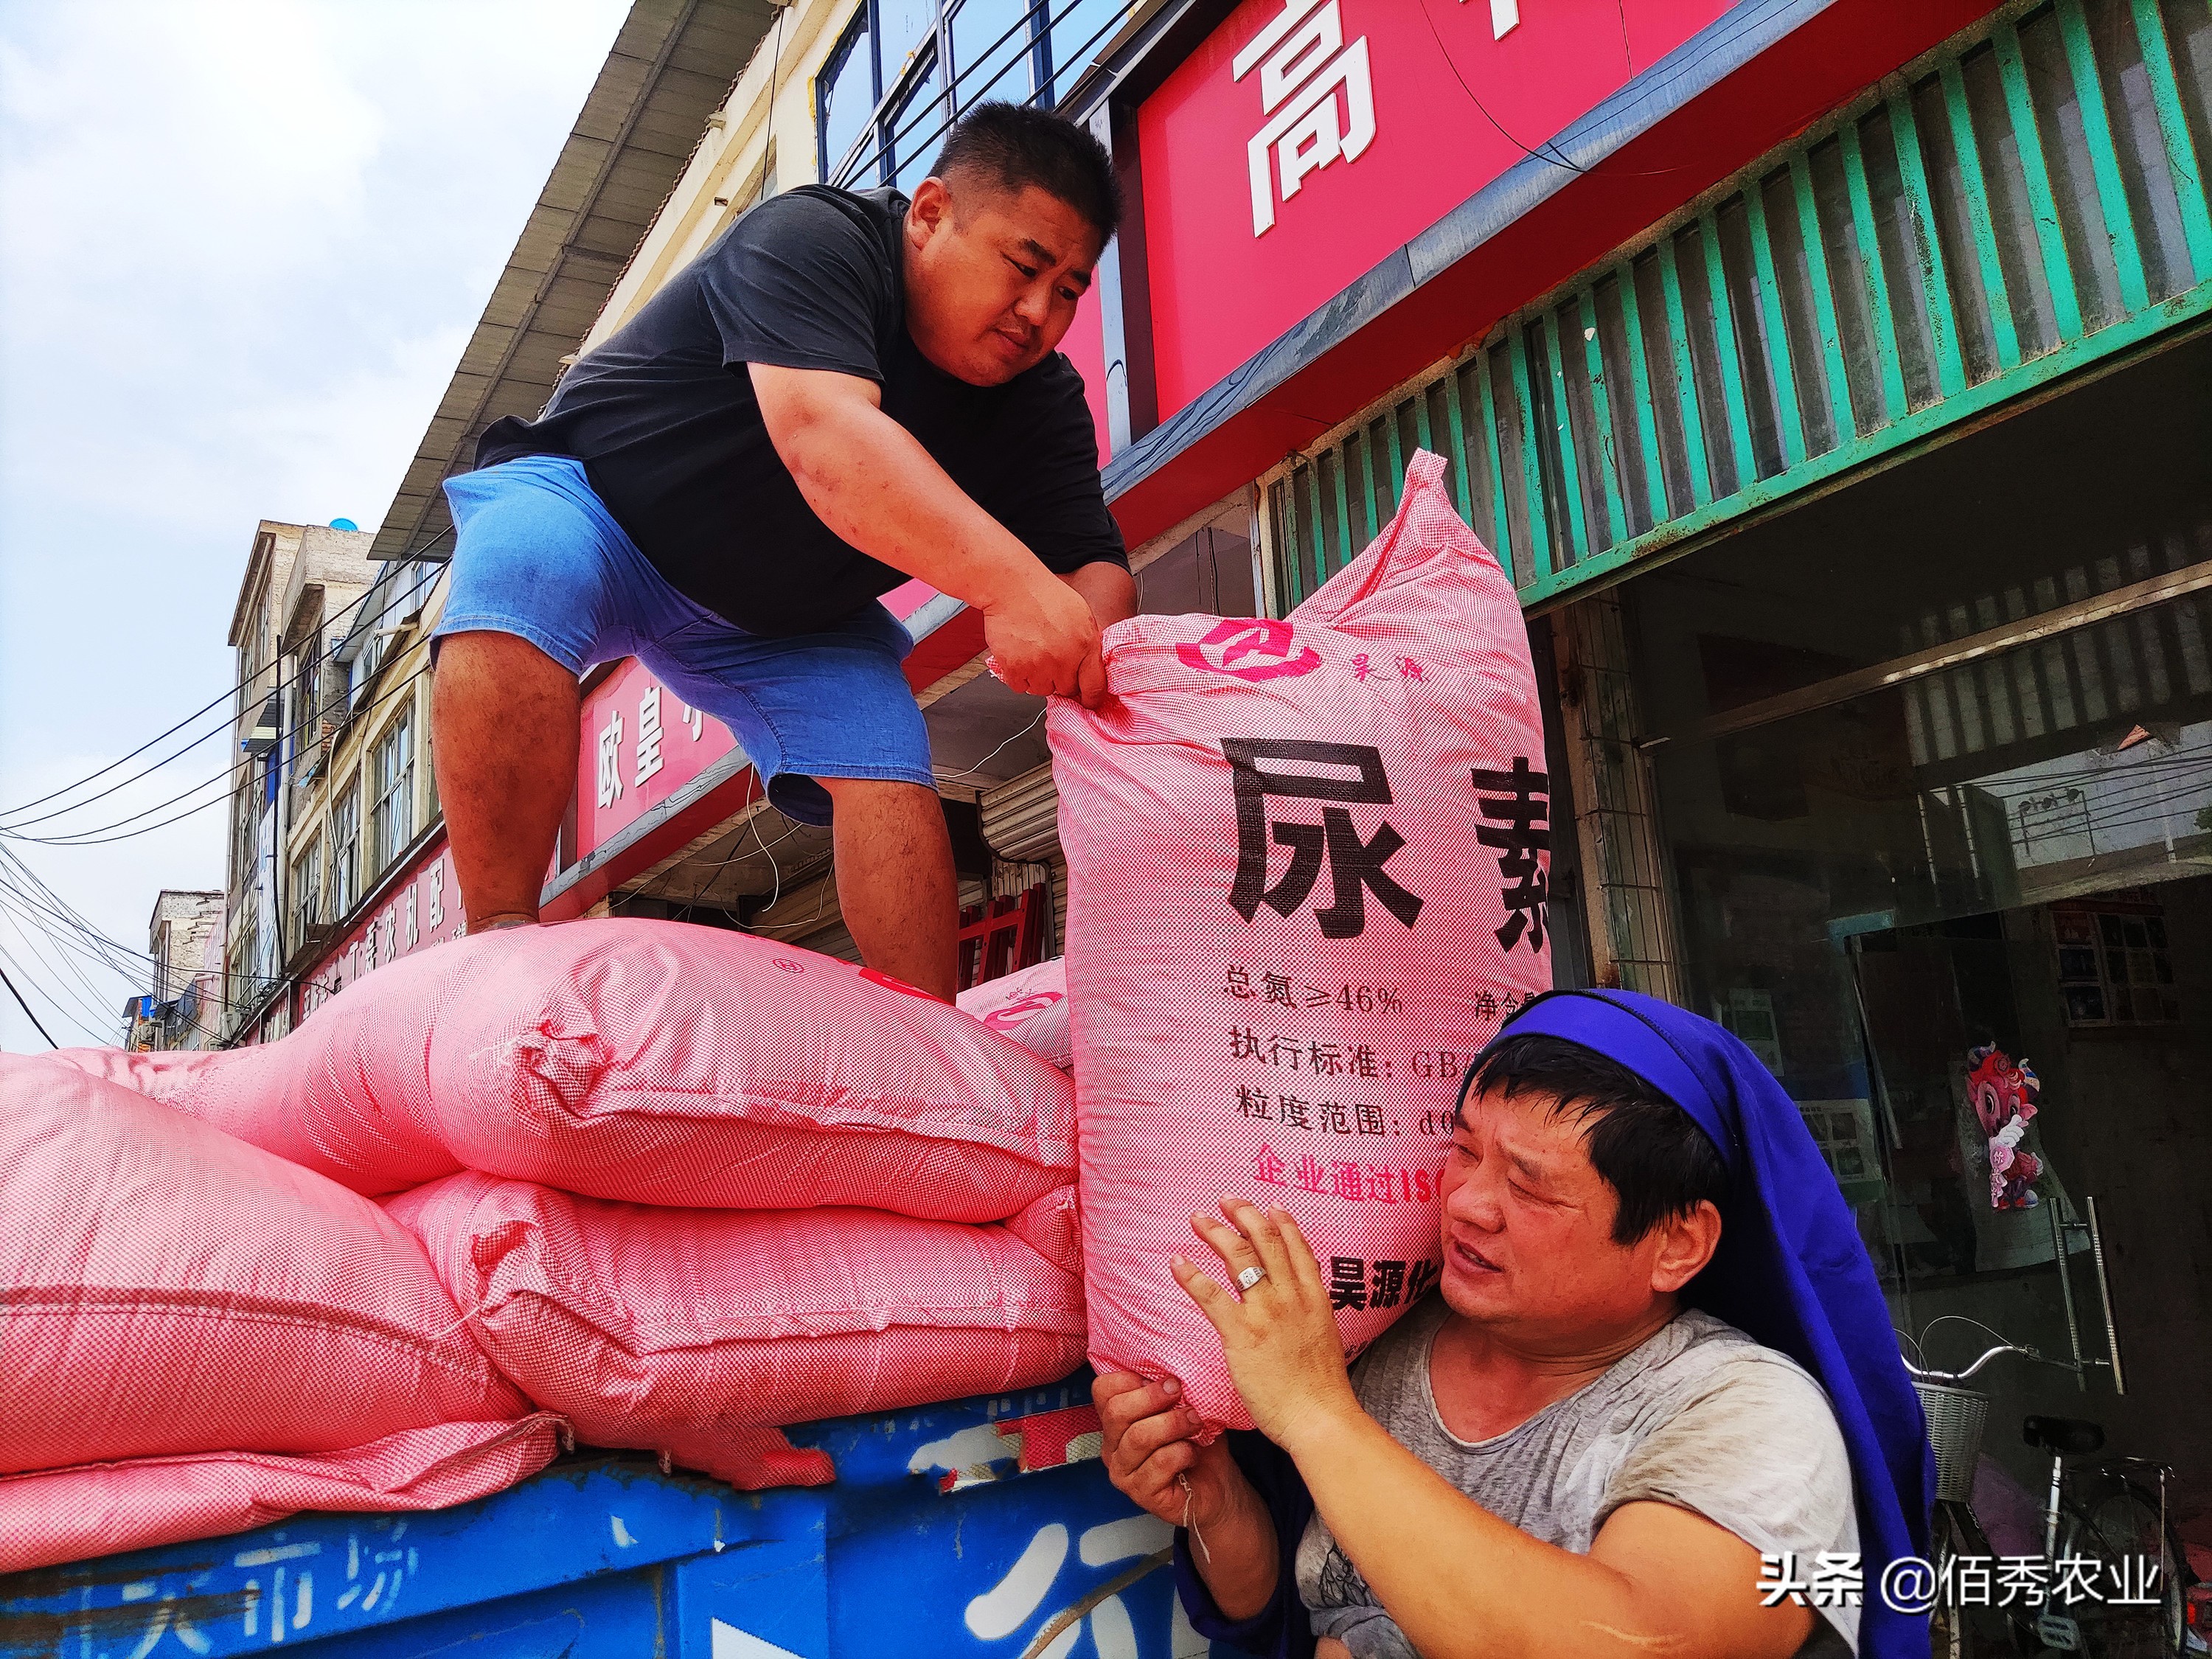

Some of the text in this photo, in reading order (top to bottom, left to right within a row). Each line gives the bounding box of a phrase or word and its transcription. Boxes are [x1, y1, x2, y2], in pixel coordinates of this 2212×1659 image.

[1220, 737, 1551, 954] 尿素
[348, 858, 463, 981] 丁磊农机配
[1253, 1144, 1445, 1205] 企业通过IS
[1329, 1256, 1439, 1312] 昊源化
